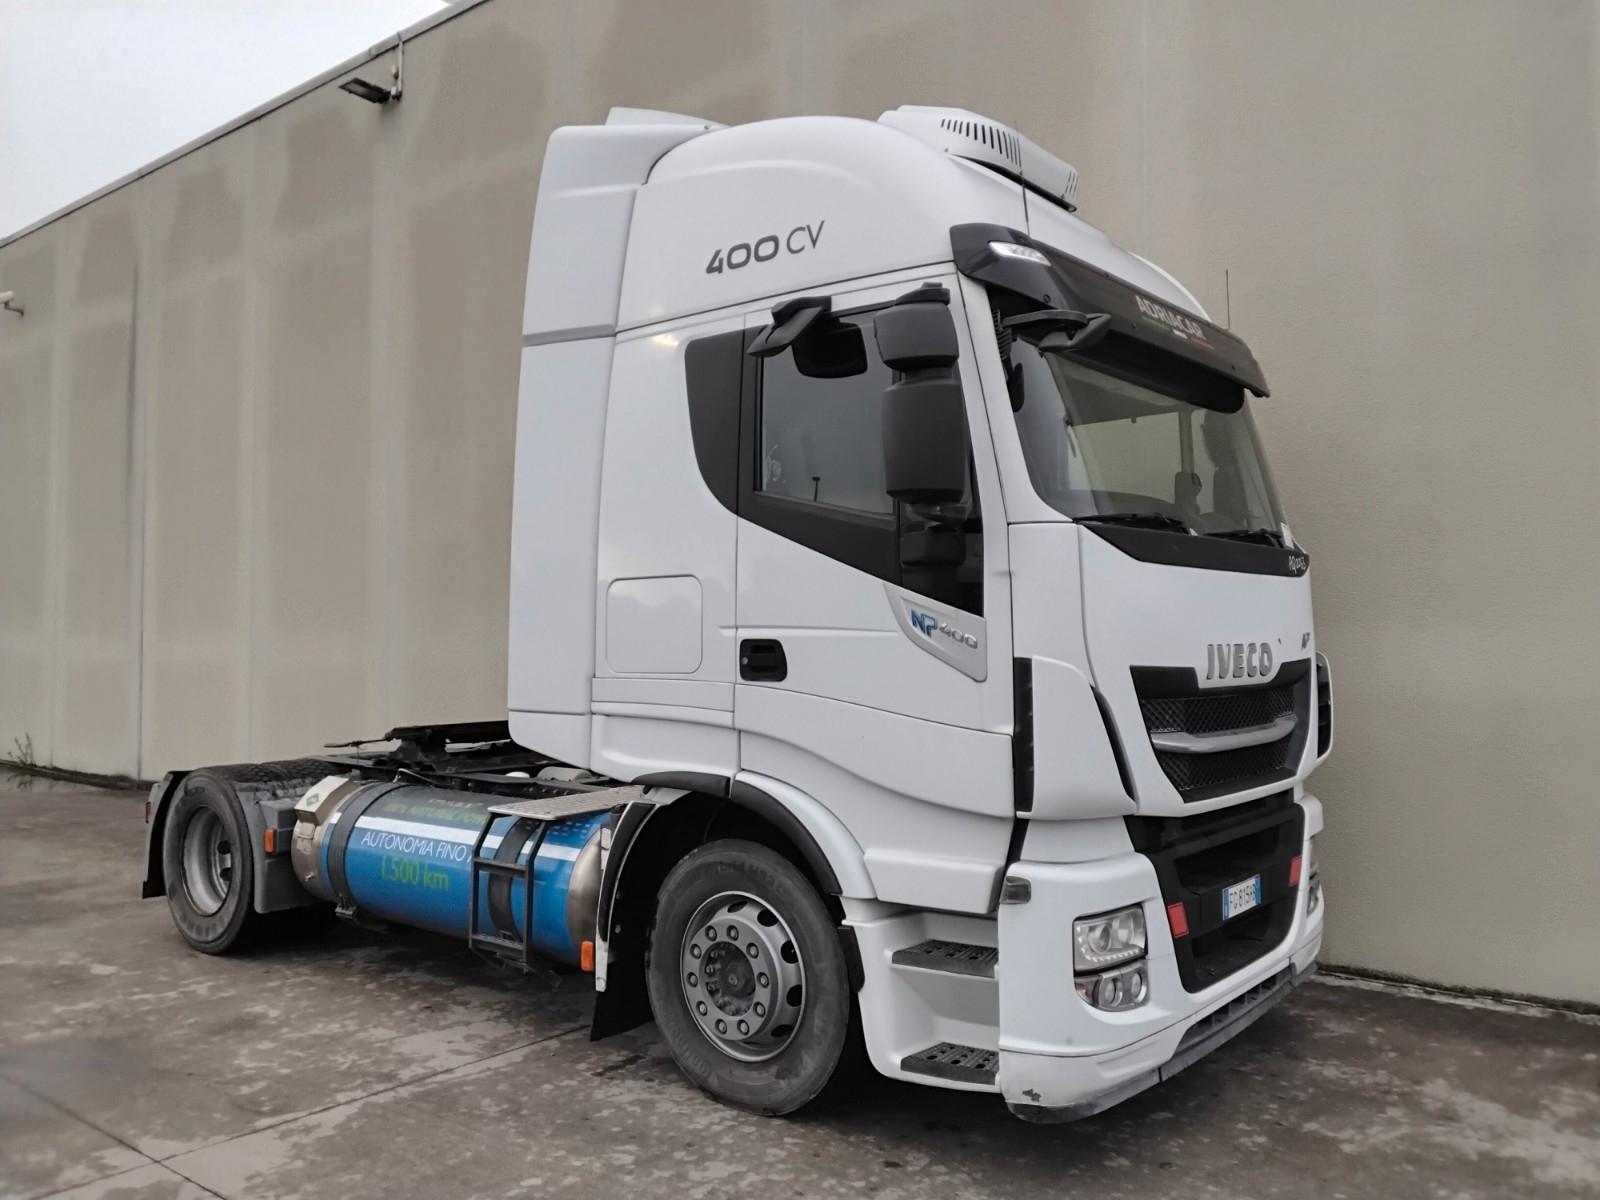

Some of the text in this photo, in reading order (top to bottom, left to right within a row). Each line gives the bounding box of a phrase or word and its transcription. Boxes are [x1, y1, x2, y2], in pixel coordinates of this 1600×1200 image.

[1206, 642, 1273, 680] IVECO
[361, 831, 434, 857] AUTONOMIA
[436, 842, 468, 862] FINO
[424, 862, 449, 891] km
